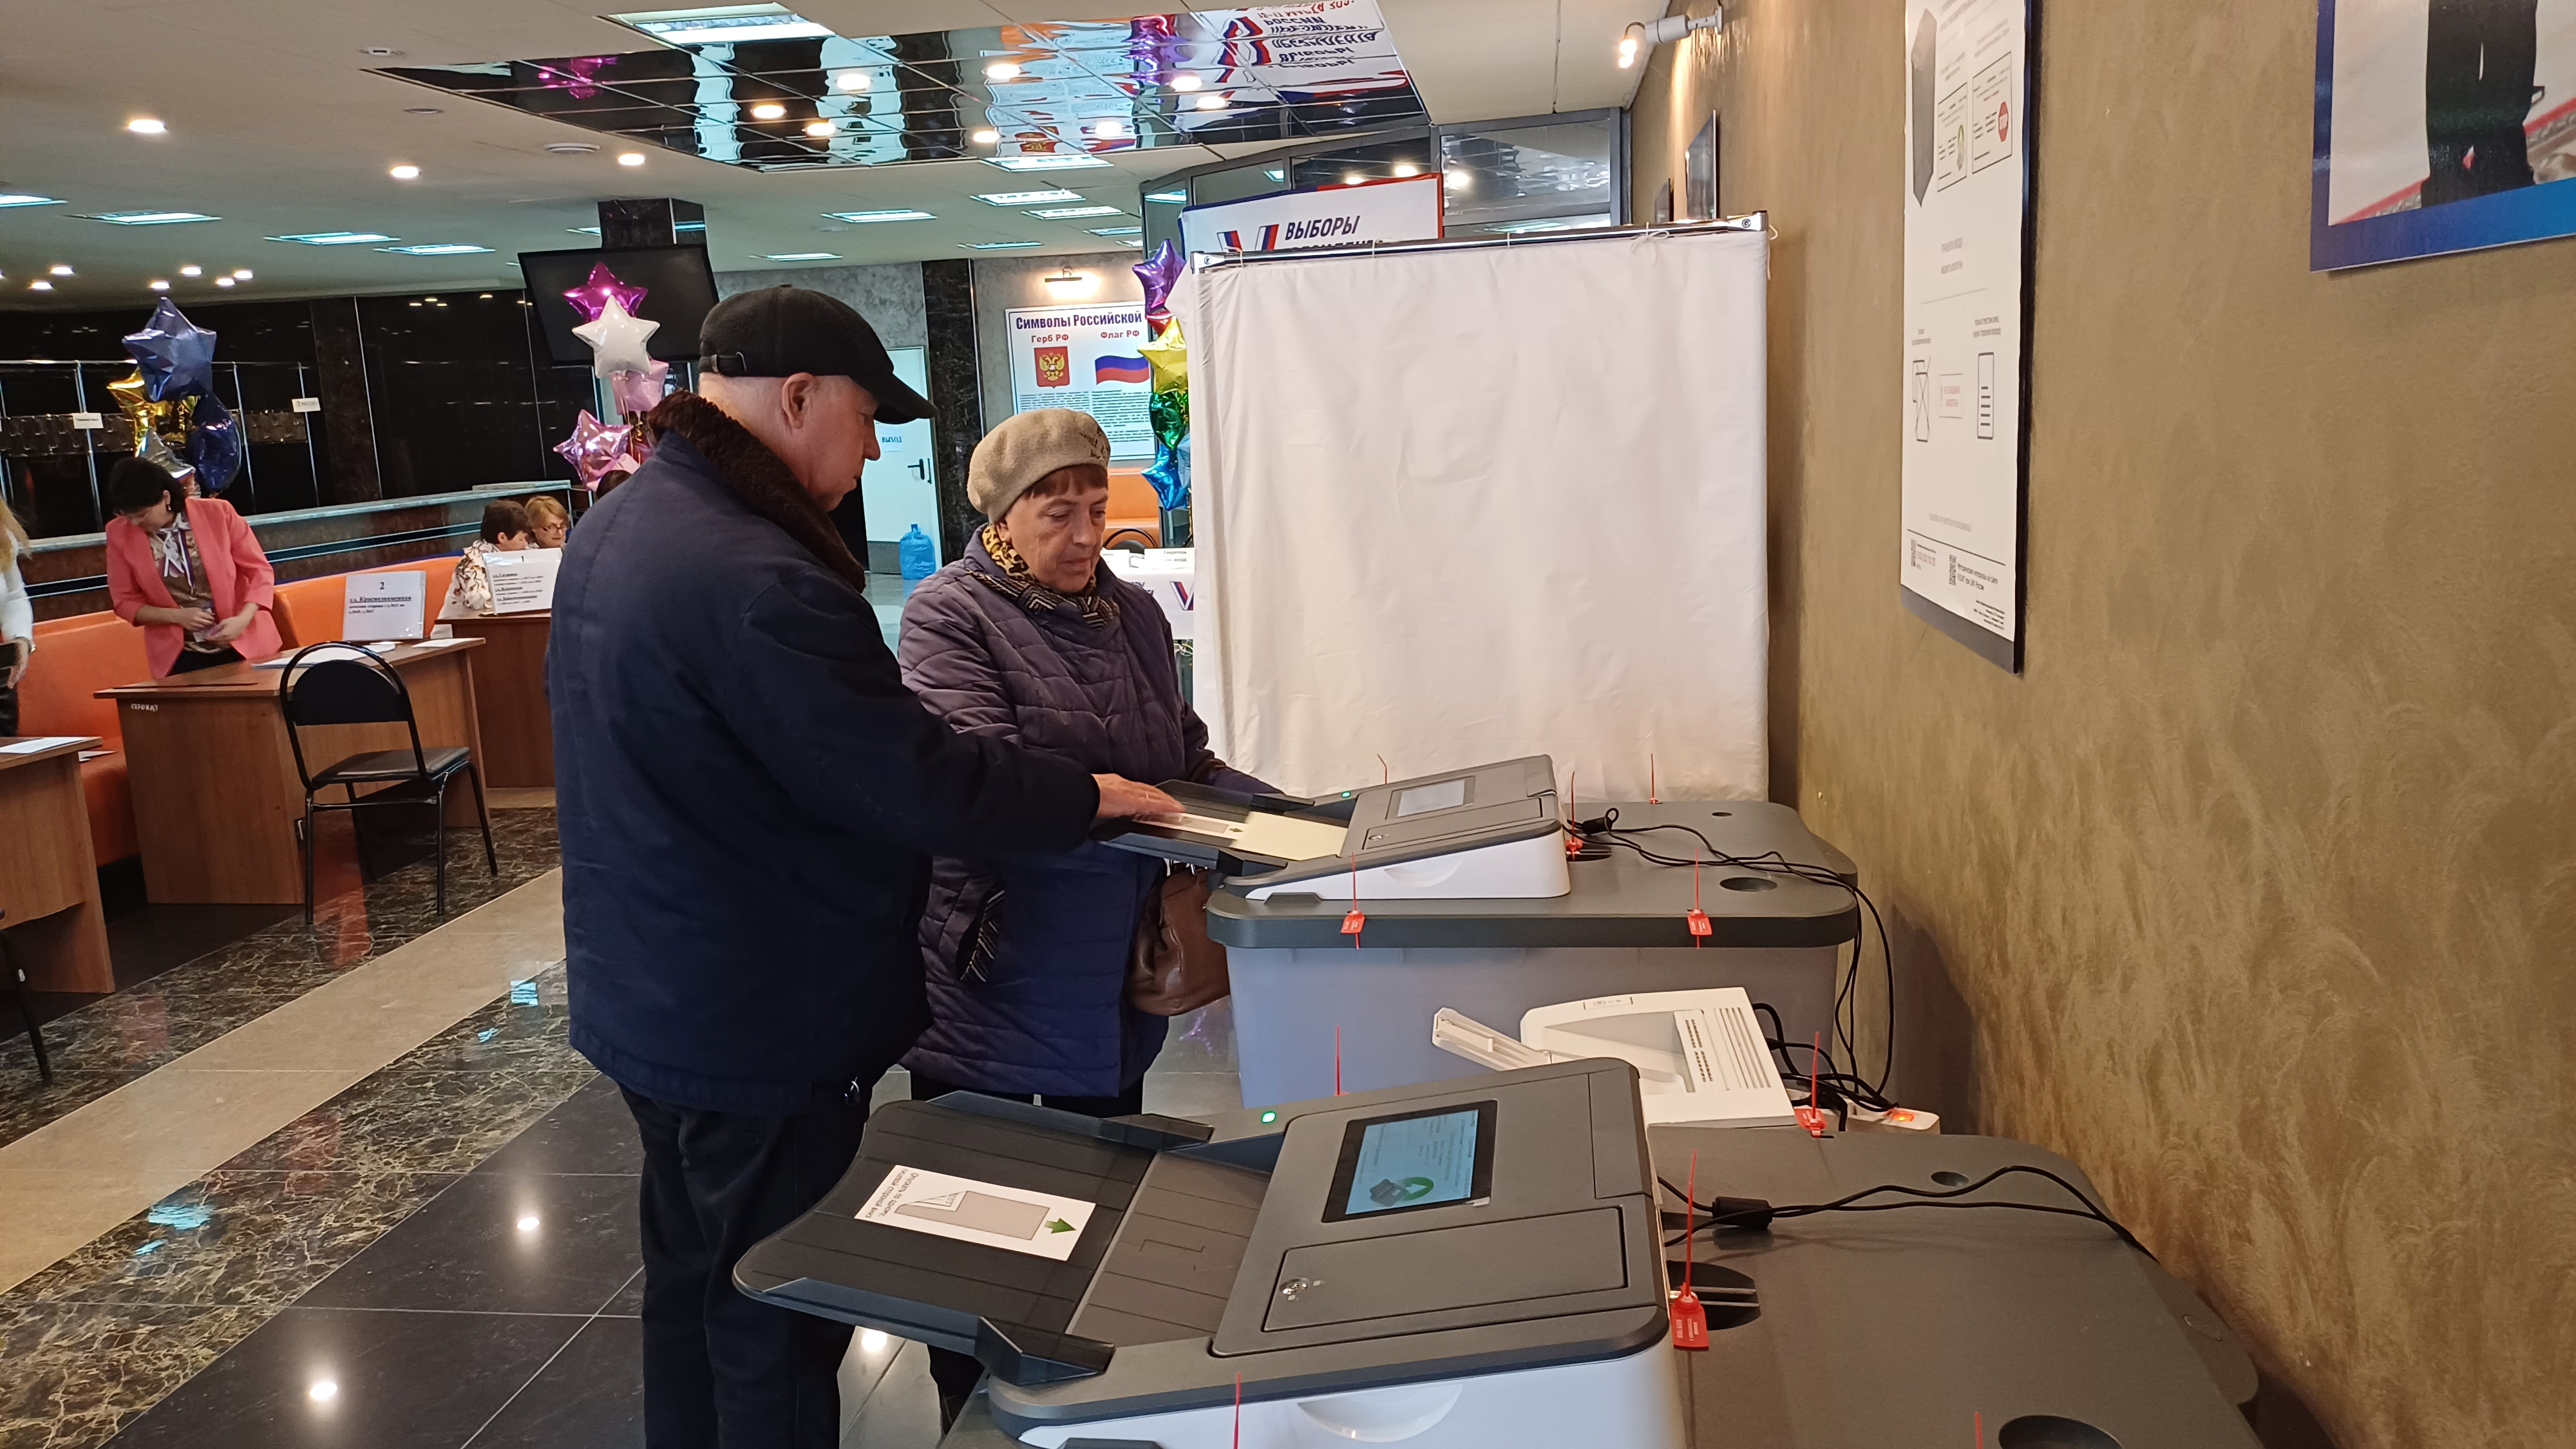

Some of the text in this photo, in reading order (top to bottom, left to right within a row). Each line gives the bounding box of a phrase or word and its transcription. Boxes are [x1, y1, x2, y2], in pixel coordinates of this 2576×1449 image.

[1285, 216, 1360, 240] ВЫБОРЫ
[1016, 310, 1142, 330] Символы Российской
[1032, 334, 1053, 344] Герб
